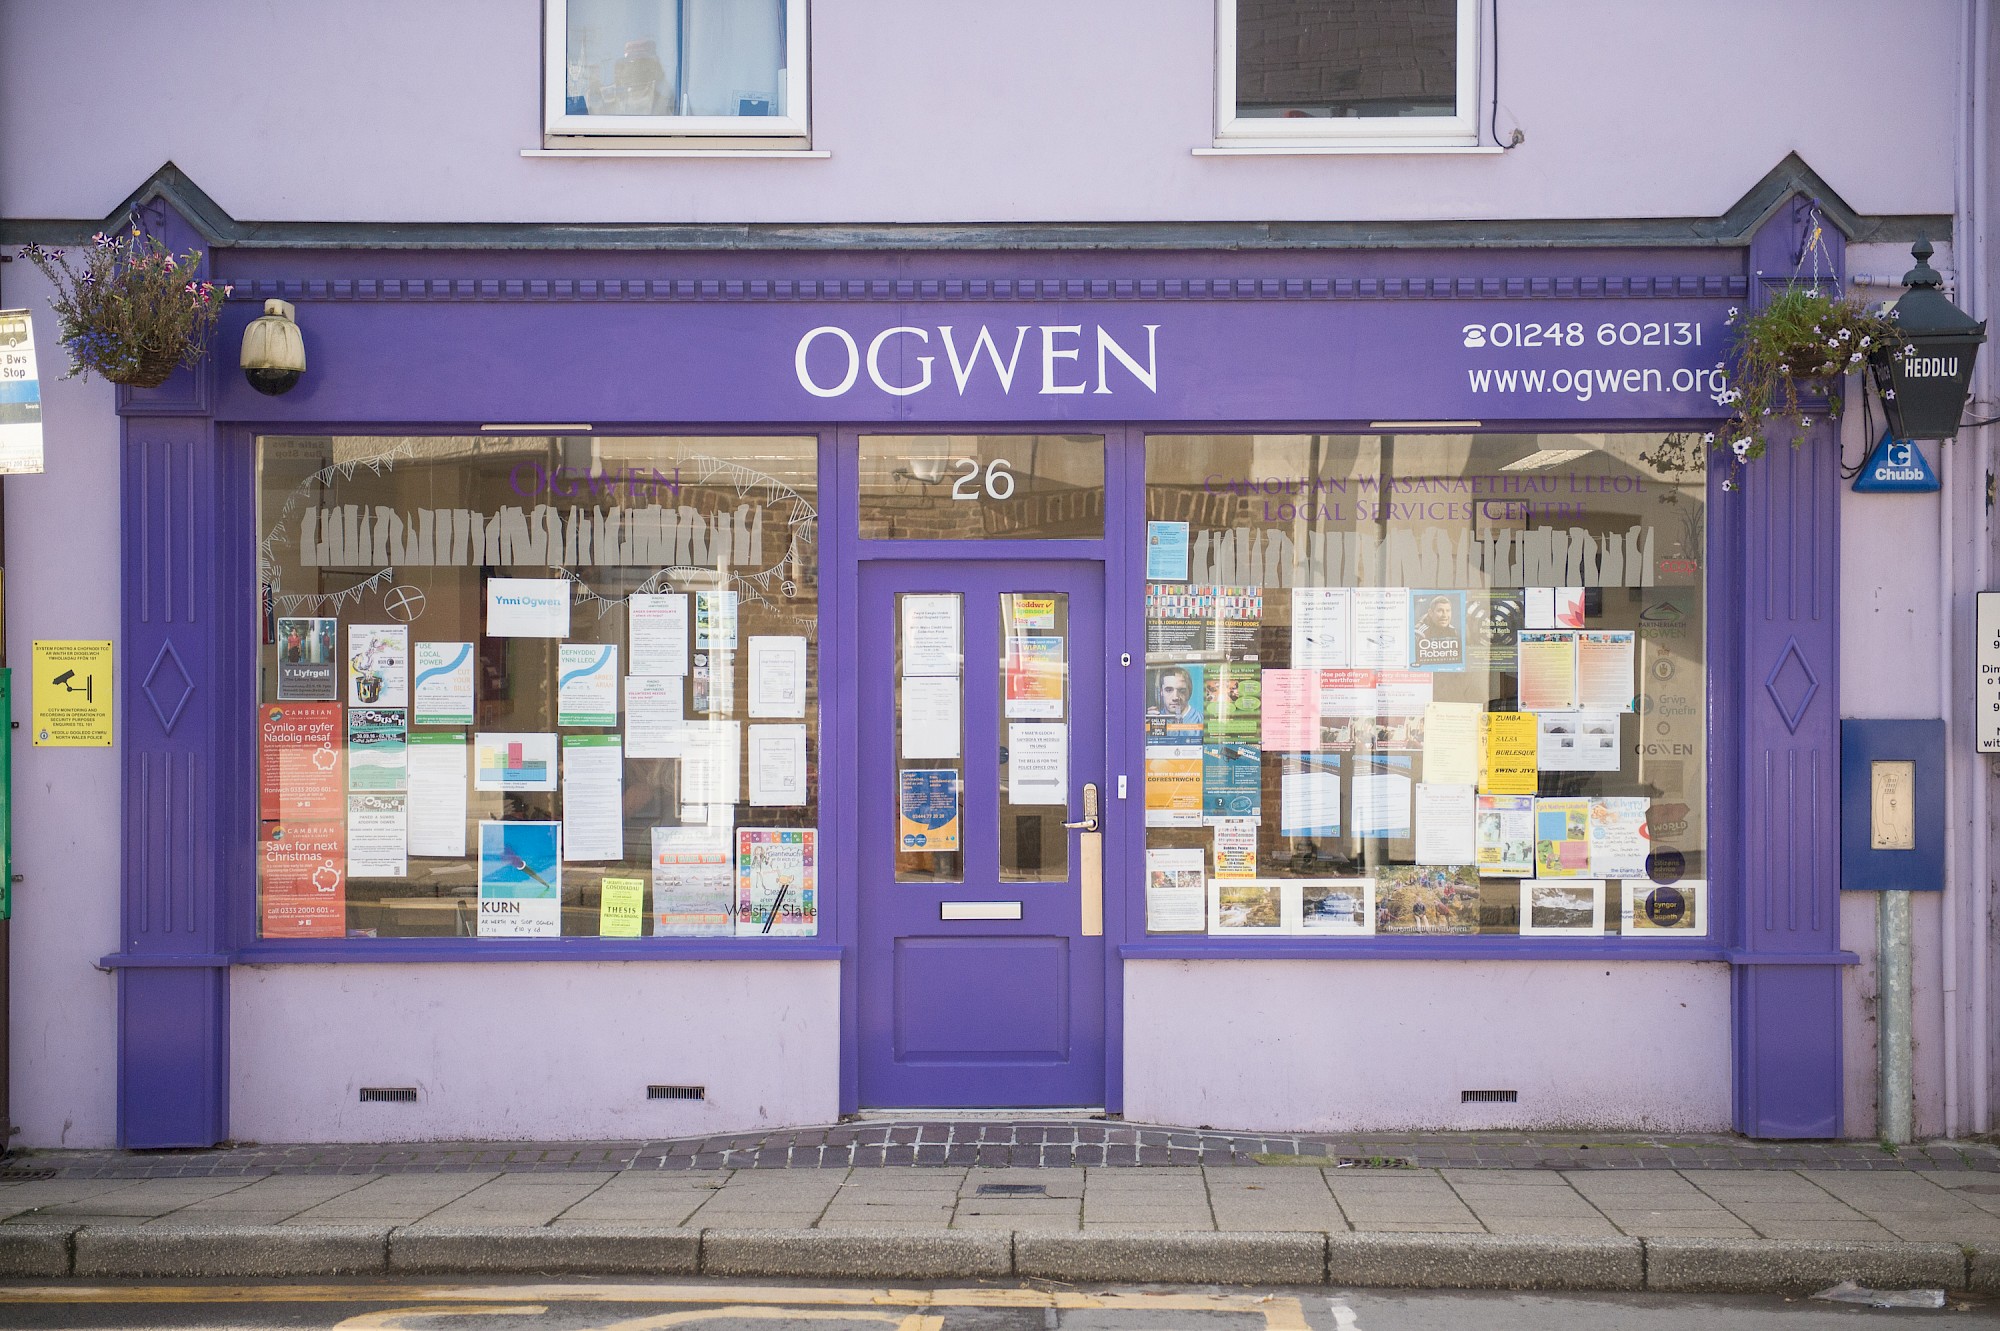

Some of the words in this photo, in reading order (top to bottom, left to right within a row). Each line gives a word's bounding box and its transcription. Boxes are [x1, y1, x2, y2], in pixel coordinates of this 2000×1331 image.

[1489, 322, 1585, 347] 01248
[1596, 322, 1702, 346] 602131
[7, 354, 27, 364] Bws
[795, 324, 1161, 398] OGWEN
[3, 367, 26, 379] Stop
[1904, 357, 1958, 378] HEDDLU
[1467, 367, 1727, 402] www.ogwen.org
[510, 461, 683, 497] OGWEN
[952, 458, 1015, 500] 26
[1875, 467, 1925, 481] Chubb
[1263, 500, 1346, 522] LOCAL
[1355, 500, 1473, 522] SERVICES
[1482, 498, 1587, 521] CENTRE
[495, 596, 520, 606] Ynni
[521, 596, 561, 608] Ogwen
[1639, 628, 1687, 638] OGWEN
[1419, 639, 1458, 650] Osian
[1419, 650, 1458, 658] Roberts
[293, 669, 330, 678] Llyfrgell
[1659, 706, 1696, 717] Cynefin
[264, 723, 295, 733] Cynilo
[310, 723, 334, 734] gyfer
[264, 733, 302, 743] Nadolig
[304, 732, 331, 741] nesaf
[1653, 821, 1687, 831] WORLD
[266, 842, 292, 851] Save
[295, 841, 310, 851] for
[314, 841, 338, 850] next
[266, 852, 322, 862] Christmas
[482, 901, 520, 913] KURN
[725, 904, 768, 916] Welsh
[783, 904, 818, 917] Slate
